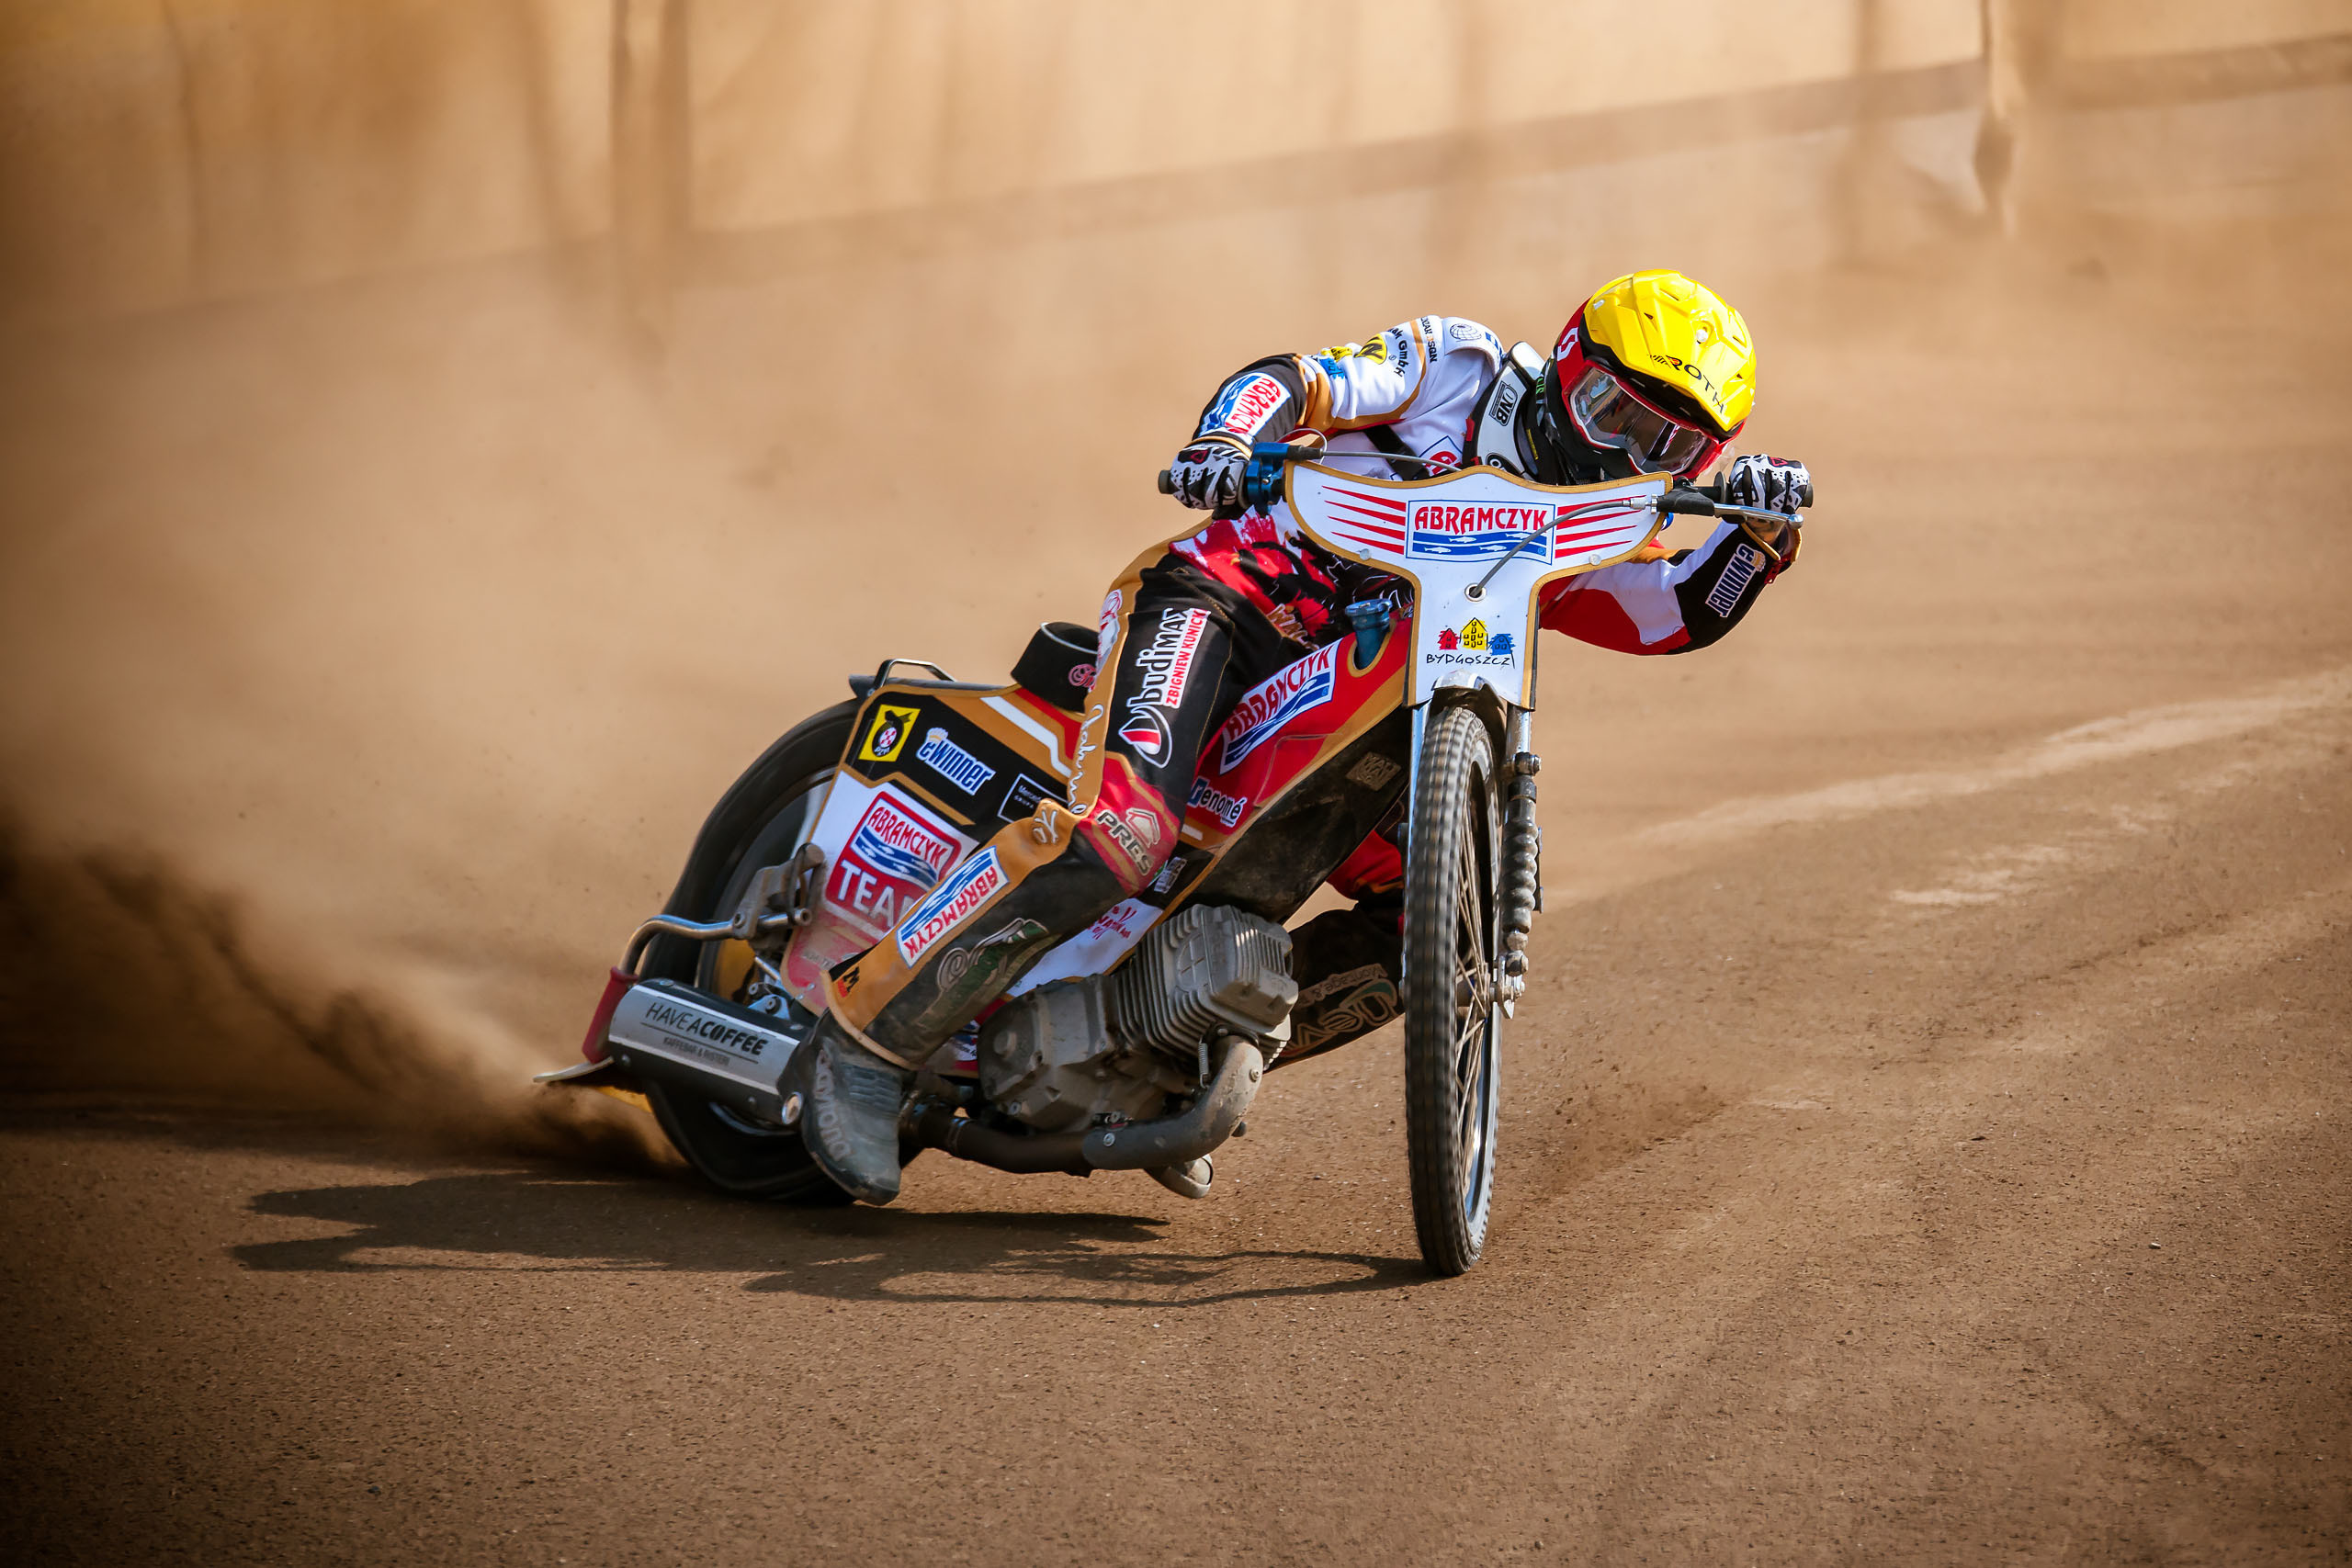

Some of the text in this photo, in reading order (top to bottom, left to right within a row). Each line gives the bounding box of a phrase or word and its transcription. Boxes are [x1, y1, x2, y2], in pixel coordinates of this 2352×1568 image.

[1414, 505, 1547, 535] ABRAMCZYK
[1165, 650, 1192, 705] ZBIGNIEW
[1425, 652, 1515, 669] BYDGOSZCZ
[1227, 644, 1336, 740] ABRAMCZYK
[866, 807, 949, 870] ABRAMCZYK
[903, 865, 999, 960] ABRAMCZYK
